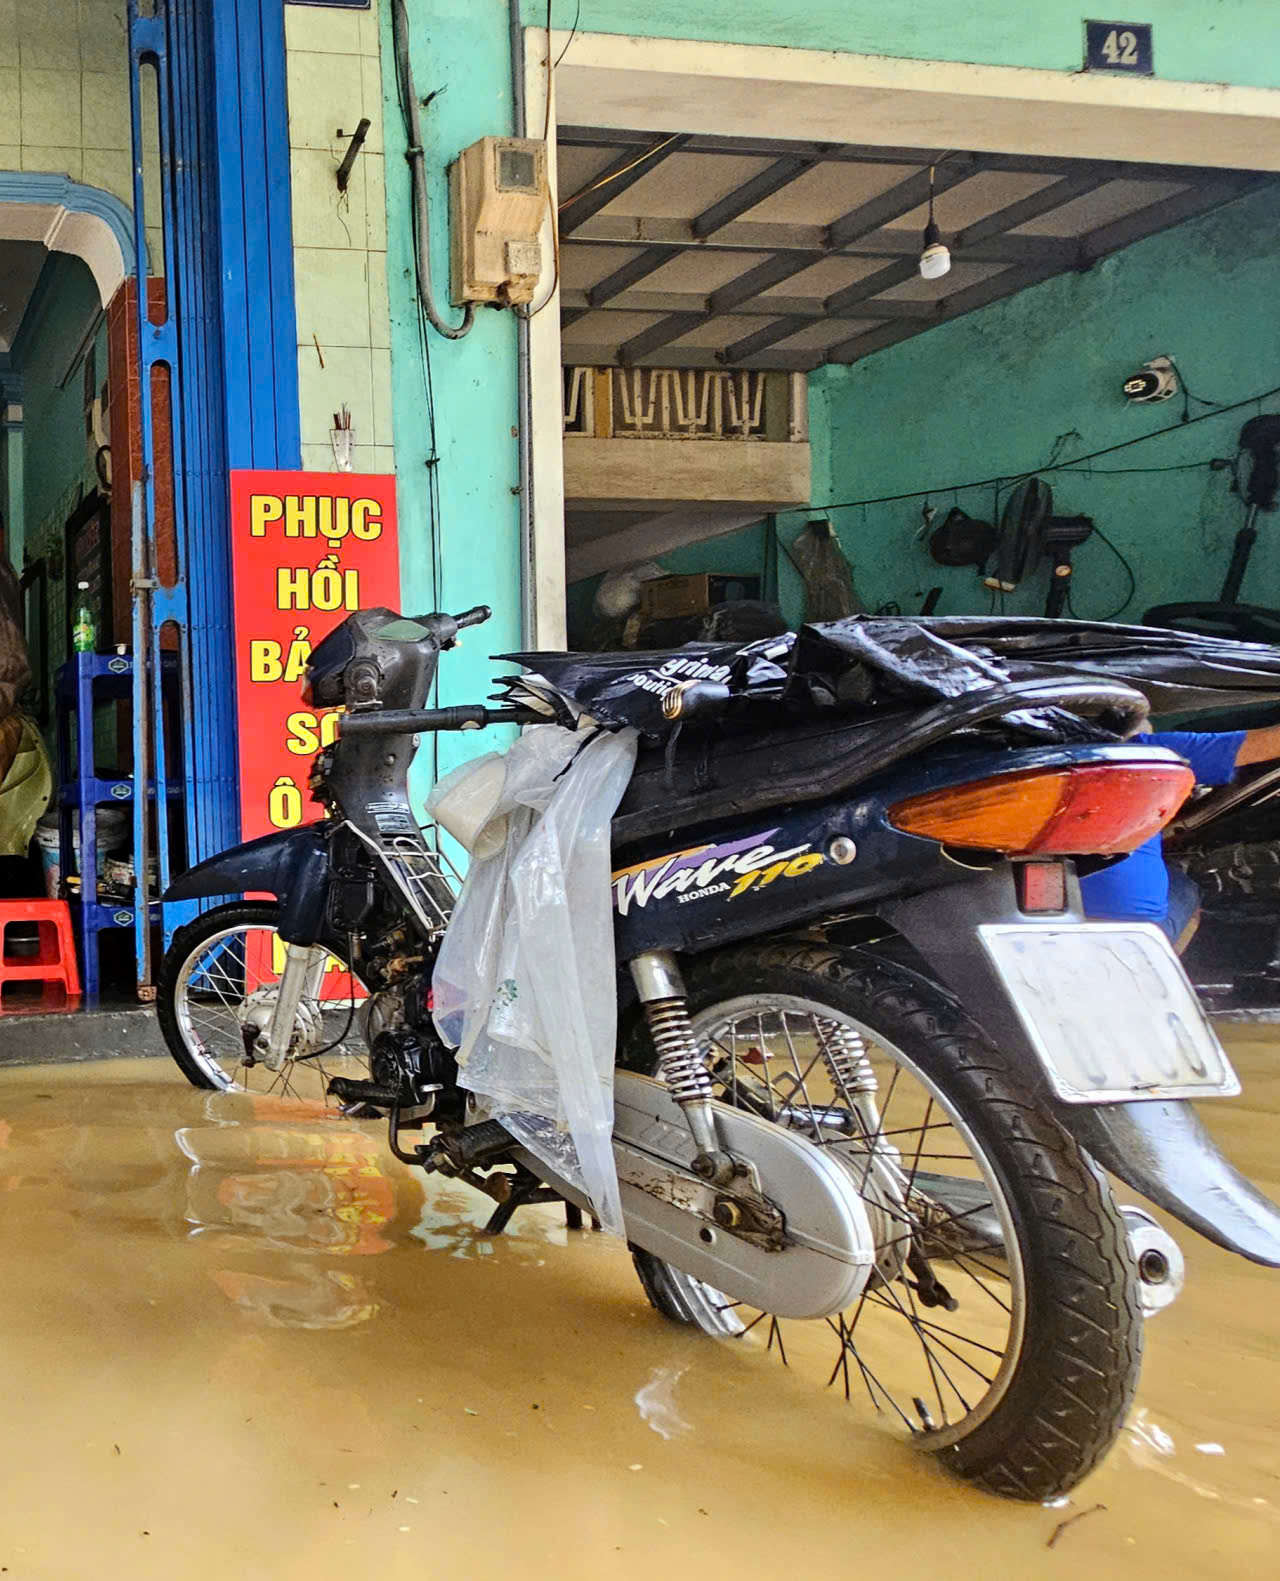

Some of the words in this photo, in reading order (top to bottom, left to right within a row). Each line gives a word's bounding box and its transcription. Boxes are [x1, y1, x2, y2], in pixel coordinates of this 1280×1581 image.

[1101, 30, 1138, 65] 42
[250, 494, 383, 549] PHỤC
[276, 553, 360, 612] HỒI
[250, 626, 314, 683] BẢ
[611, 843, 812, 916] Wave
[677, 881, 731, 903] HONDA
